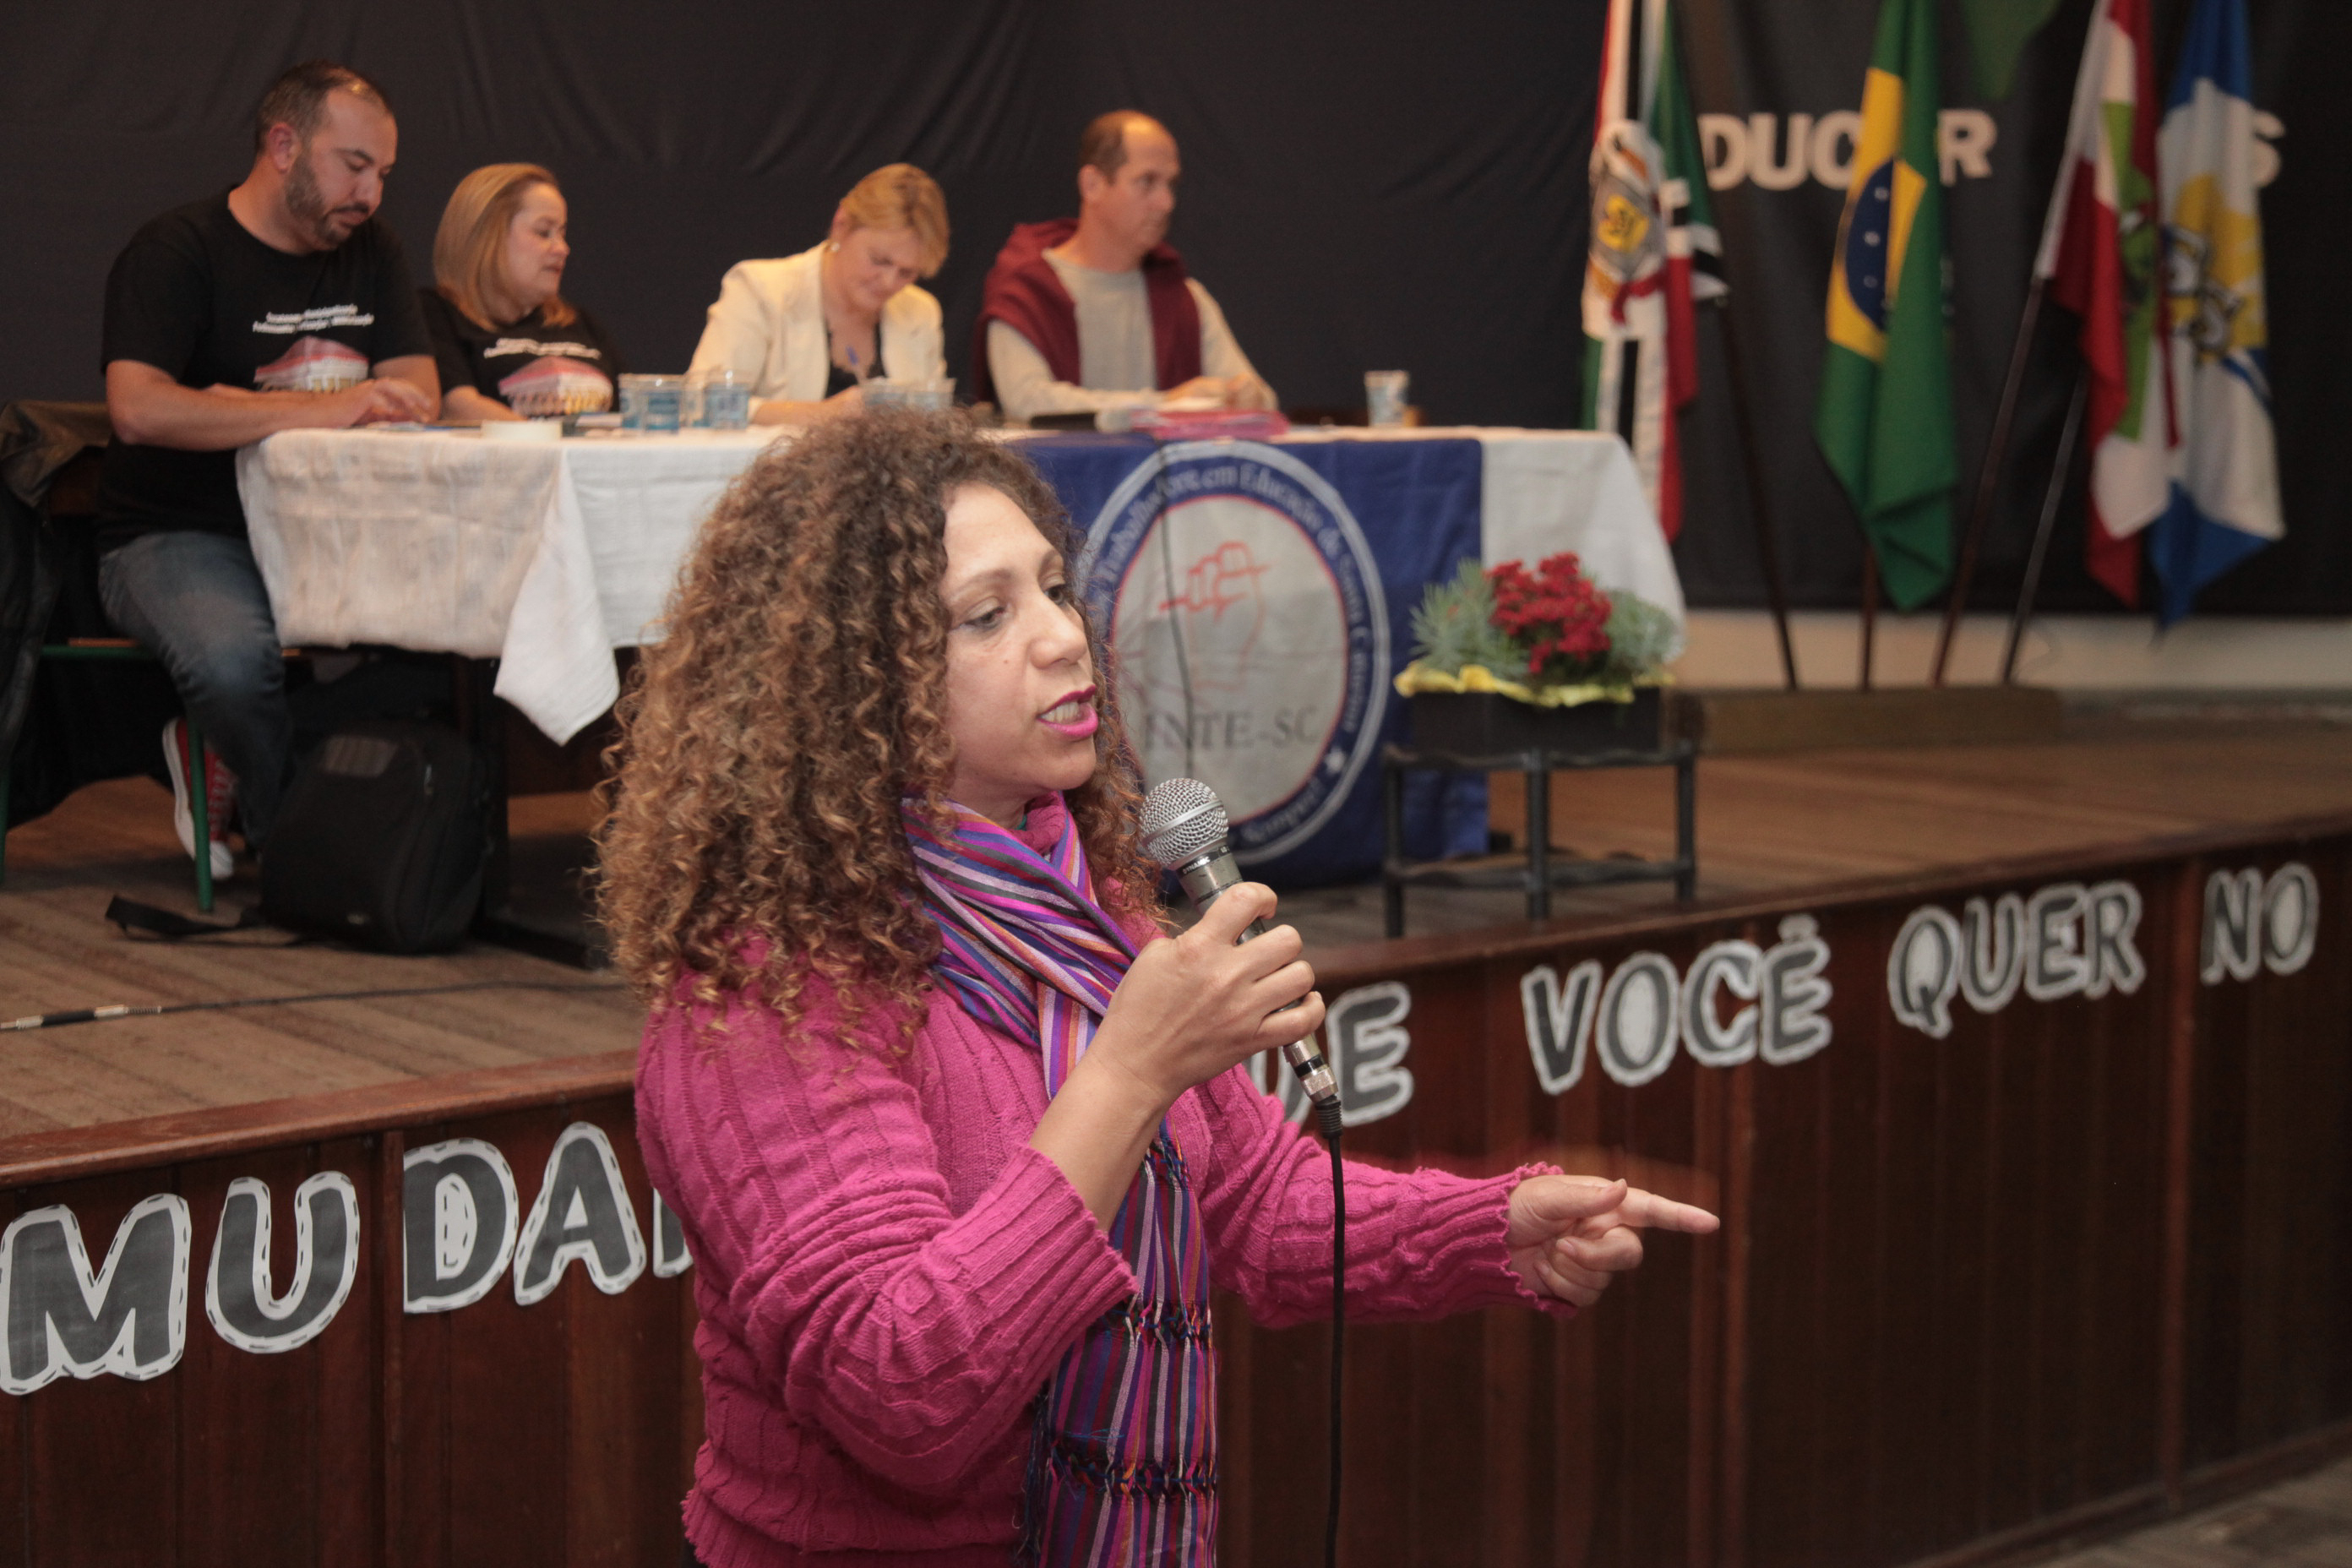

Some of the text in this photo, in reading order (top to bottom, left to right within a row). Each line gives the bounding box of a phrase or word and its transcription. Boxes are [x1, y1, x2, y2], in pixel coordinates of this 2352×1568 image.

[1696, 109, 1998, 191] DUCR
[1520, 912, 1832, 1096] VOCÊ
[1886, 879, 2147, 1039] QUER
[2199, 861, 2320, 987] NO
